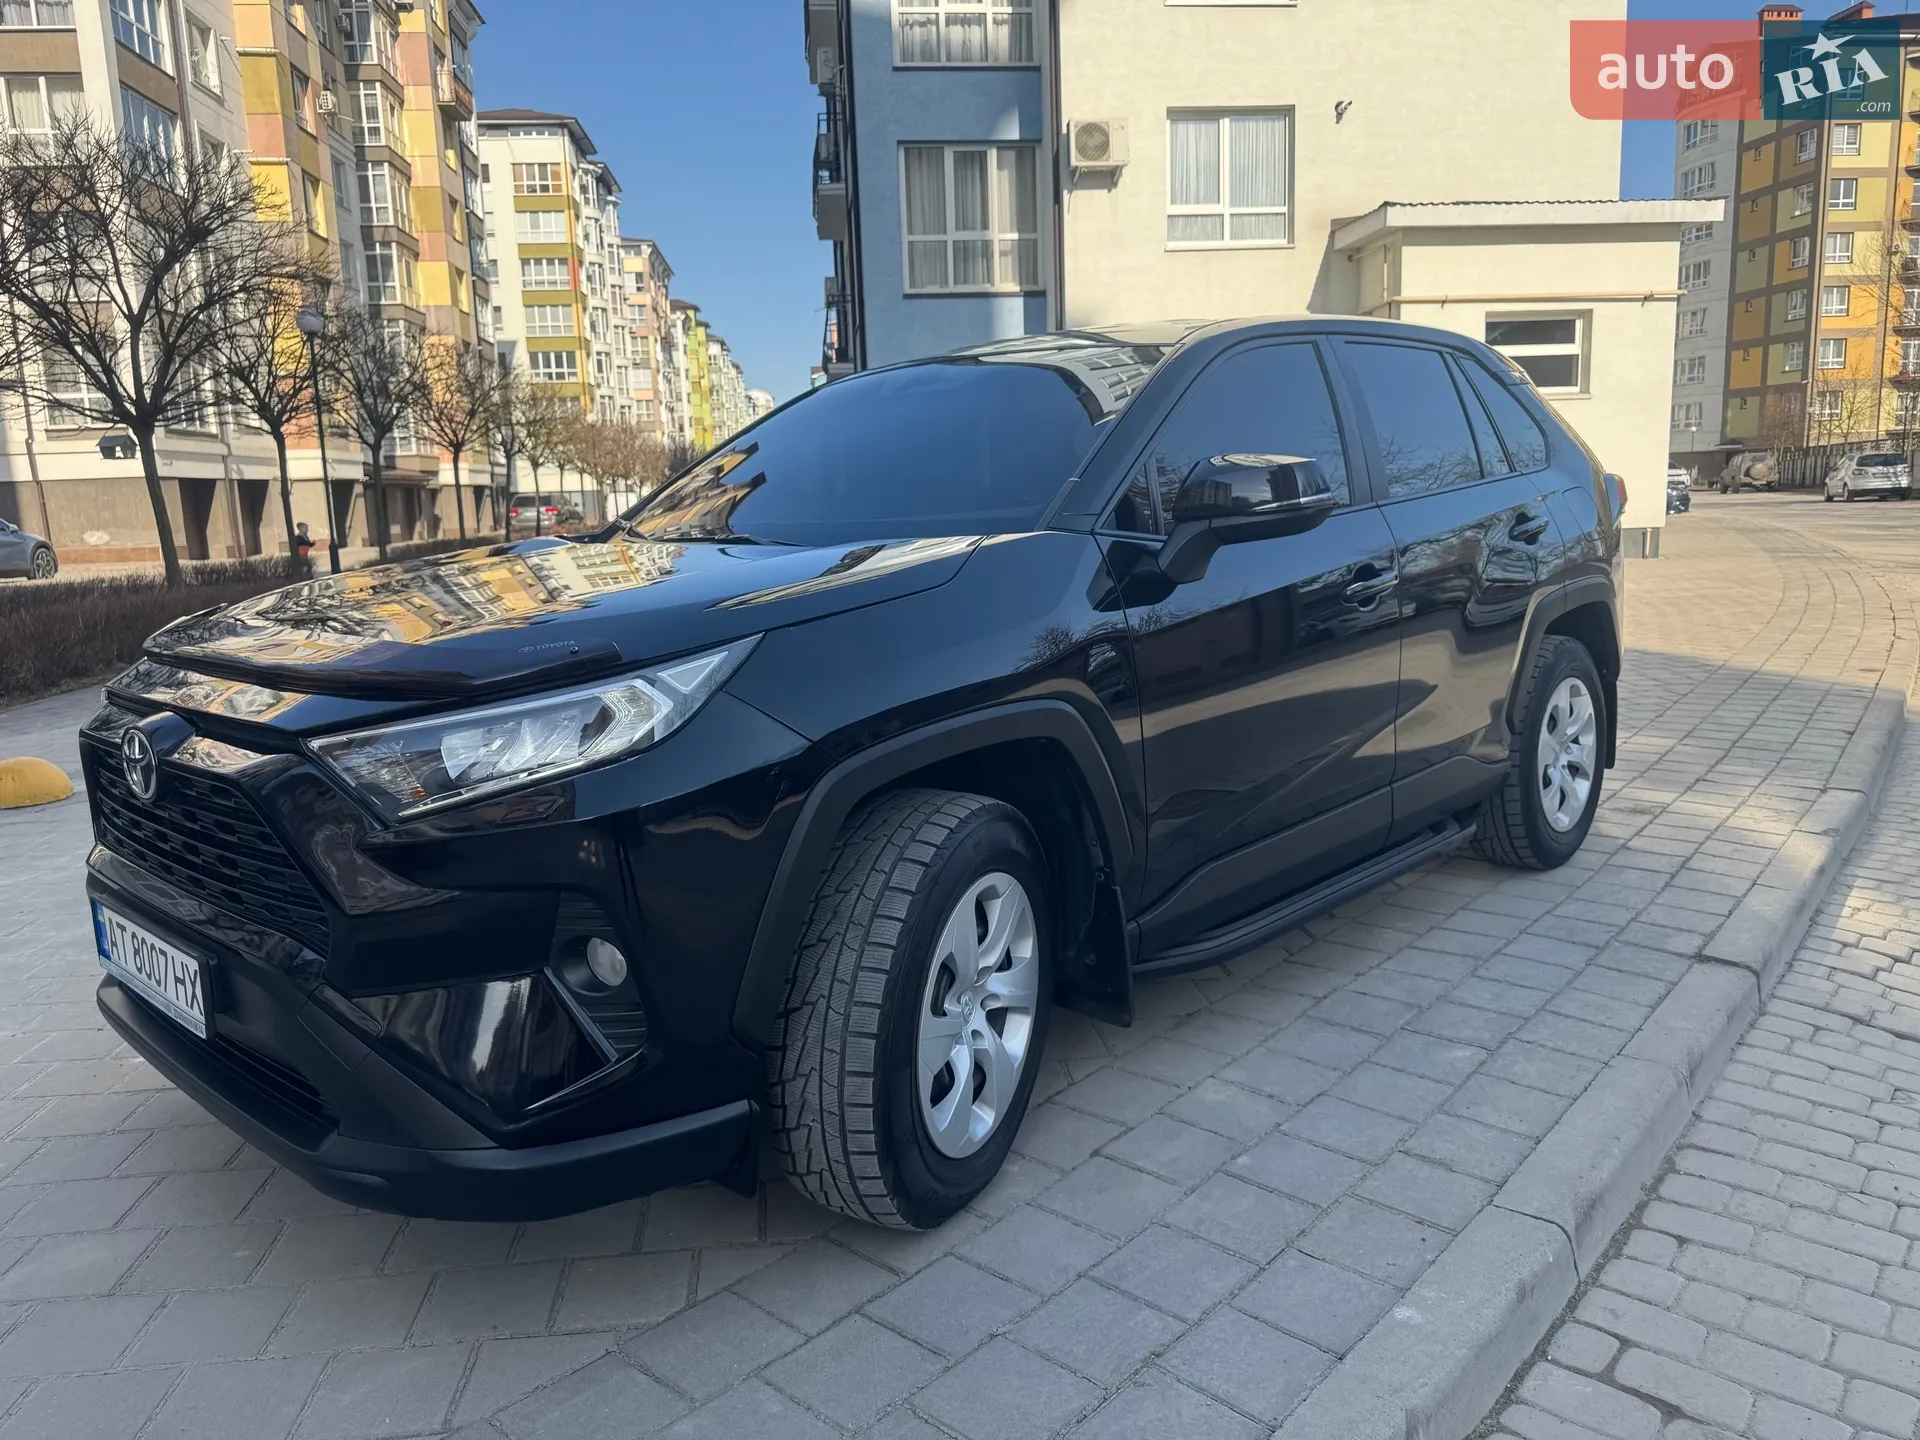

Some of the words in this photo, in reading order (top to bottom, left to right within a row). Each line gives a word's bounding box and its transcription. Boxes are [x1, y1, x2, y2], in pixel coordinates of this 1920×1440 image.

[535, 640, 576, 650] TOYOTA
[108, 916, 128, 966] AT
[131, 931, 169, 993] 8007
[171, 955, 204, 1017] HX
